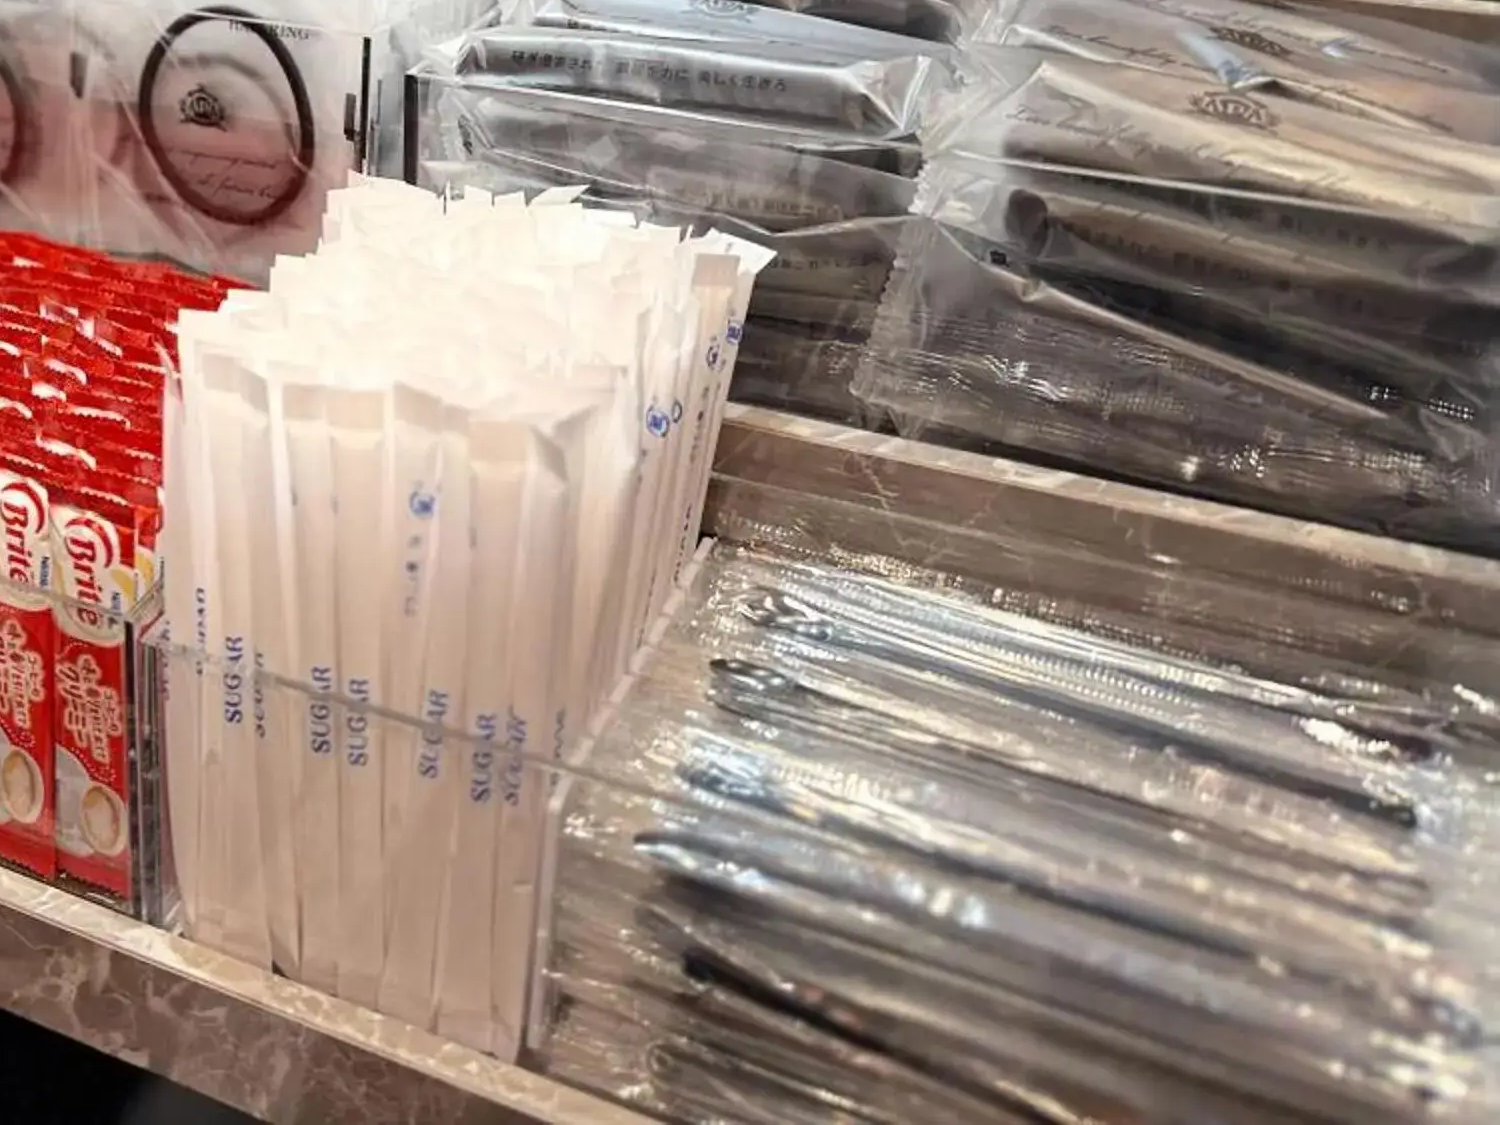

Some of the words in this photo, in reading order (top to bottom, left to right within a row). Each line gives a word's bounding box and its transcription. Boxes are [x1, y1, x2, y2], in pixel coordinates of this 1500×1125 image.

[1201, 95, 1268, 124] APA
[1, 503, 35, 583] Brite
[65, 540, 103, 626] Brite
[224, 636, 243, 723] SUGAR
[418, 689, 448, 778] SUGAR
[471, 714, 496, 803] SUGAR
